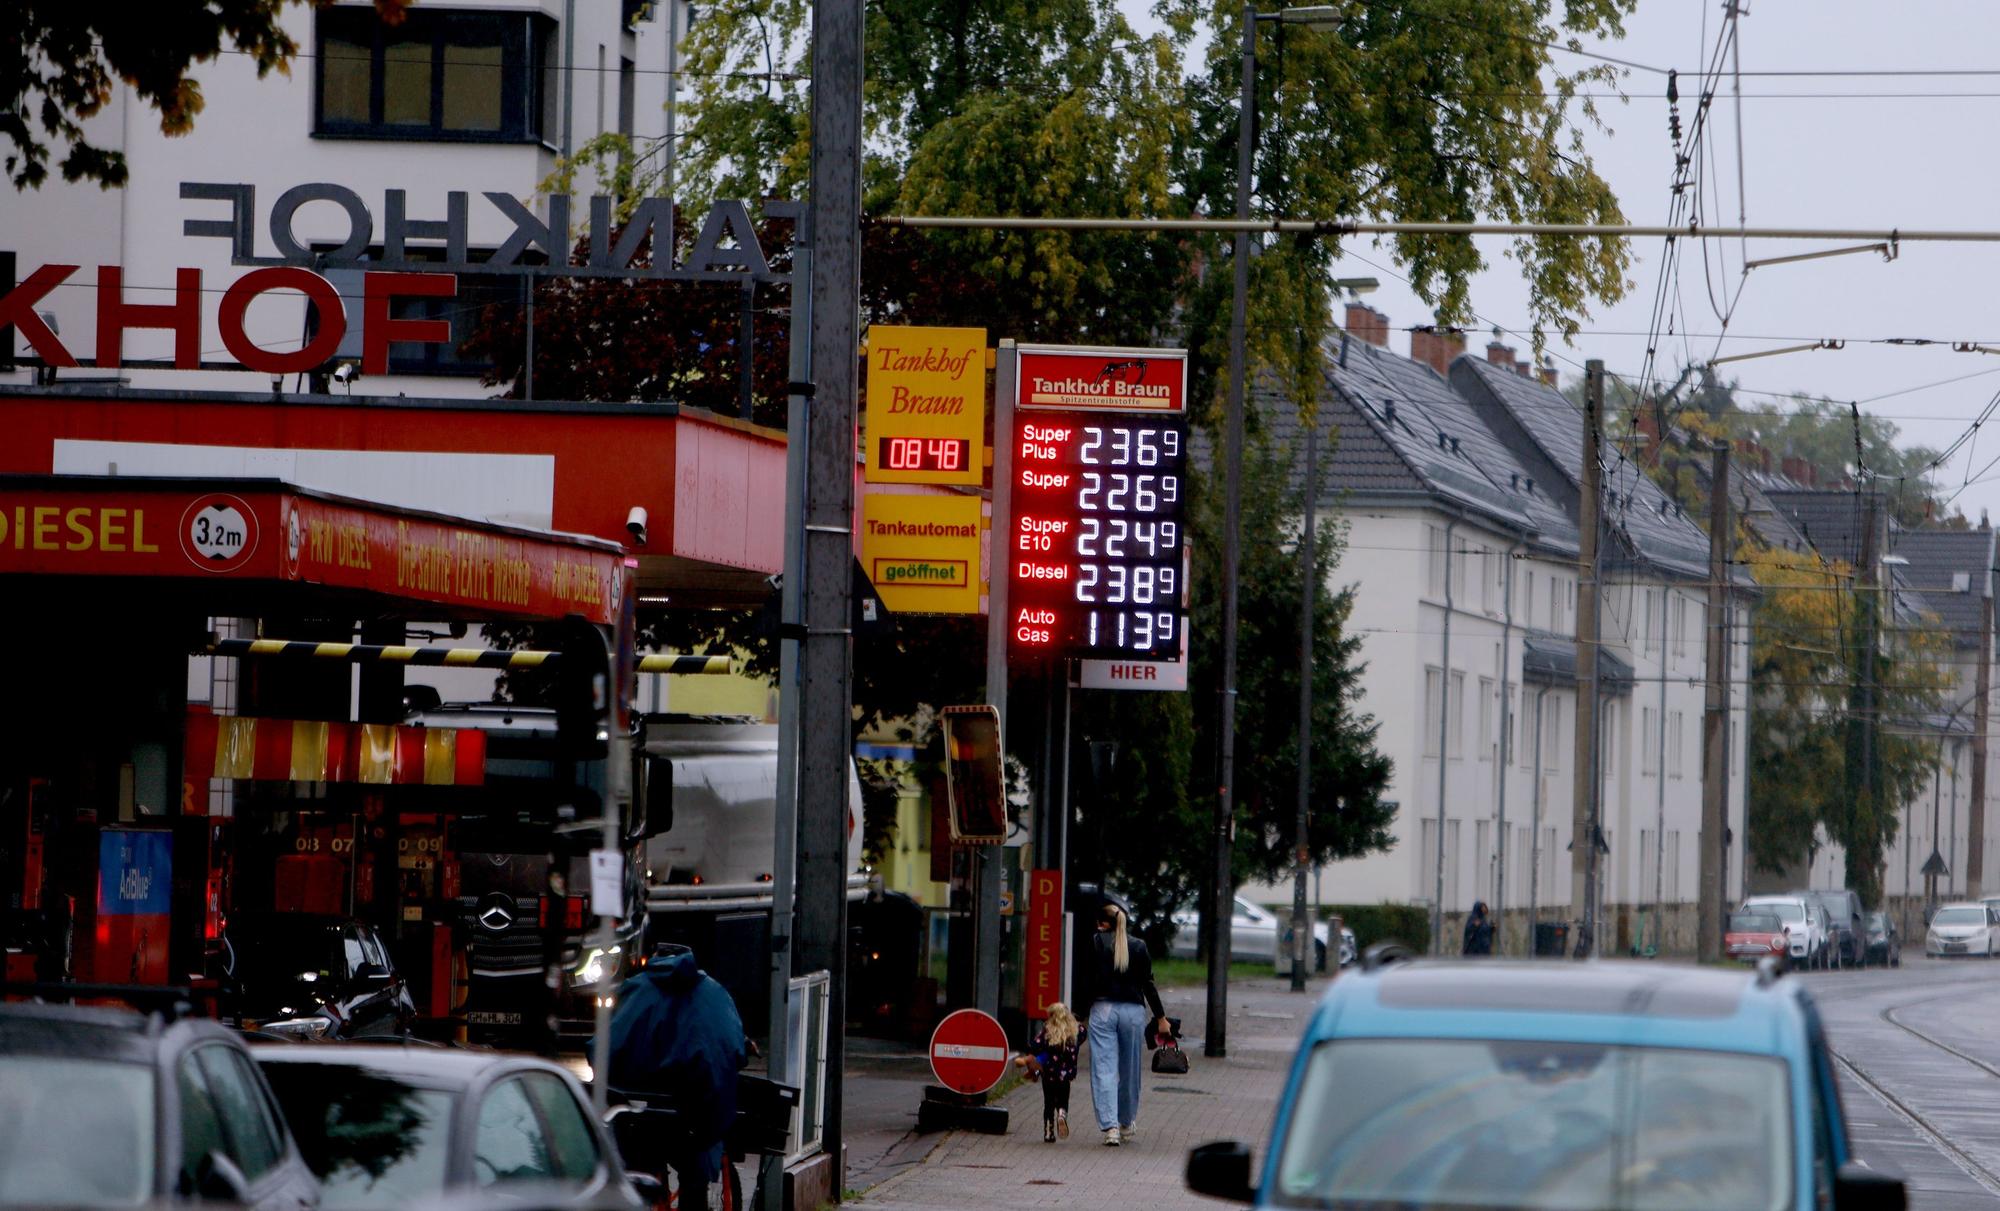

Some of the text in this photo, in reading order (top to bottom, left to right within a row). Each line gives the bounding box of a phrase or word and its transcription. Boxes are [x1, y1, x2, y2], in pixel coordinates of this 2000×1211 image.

[877, 347, 977, 380] Tankhof
[1033, 377, 1170, 397] Tankhof Braun
[887, 385, 964, 415] Braun
[1060, 395, 1141, 406] Spitzentreibstoffe
[1023, 425, 1071, 443] Super
[1022, 444, 1057, 460] Plus
[1021, 471, 1069, 489] Super
[0, 506, 159, 552] IESEL
[867, 520, 976, 537] Tankautomat
[1020, 516, 1068, 535] Super
[310, 520, 333, 564] PKW
[338, 525, 371, 570] DIESEL
[1019, 535, 1051, 551] E10
[885, 563, 956, 581] geöffnet
[1018, 563, 1068, 579] Diesel
[1018, 608, 1055, 625] Auto
[1017, 627, 1049, 642] Gas
[1110, 665, 1157, 680] HIER
[331, 838, 353, 852] 07
[119, 867, 149, 900] AdBlue
[1038, 878, 1054, 1011] DIESEL
